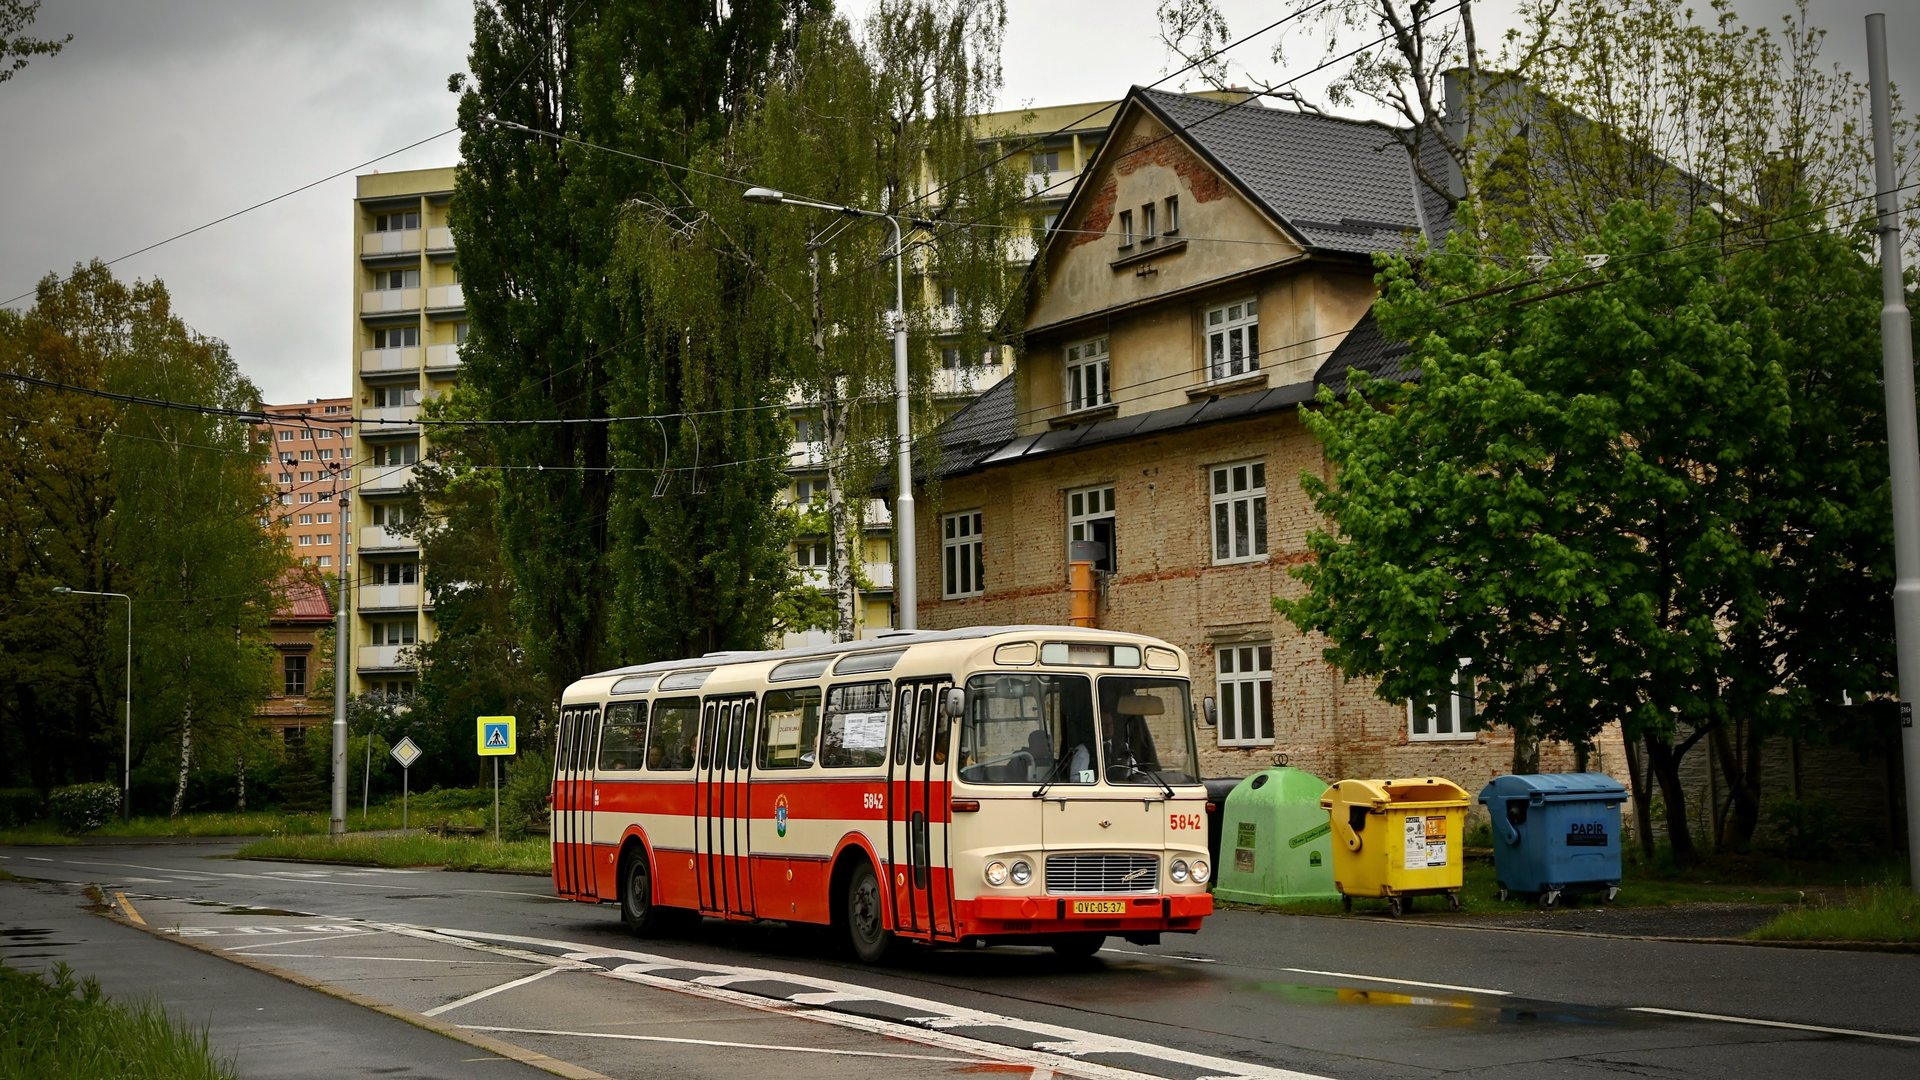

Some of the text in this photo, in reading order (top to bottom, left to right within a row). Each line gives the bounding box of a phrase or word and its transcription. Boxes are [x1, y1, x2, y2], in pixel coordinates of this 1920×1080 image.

[863, 793, 884, 809] 5842
[1170, 814, 1201, 830] 5842
[1571, 820, 1604, 835] PAPÍR
